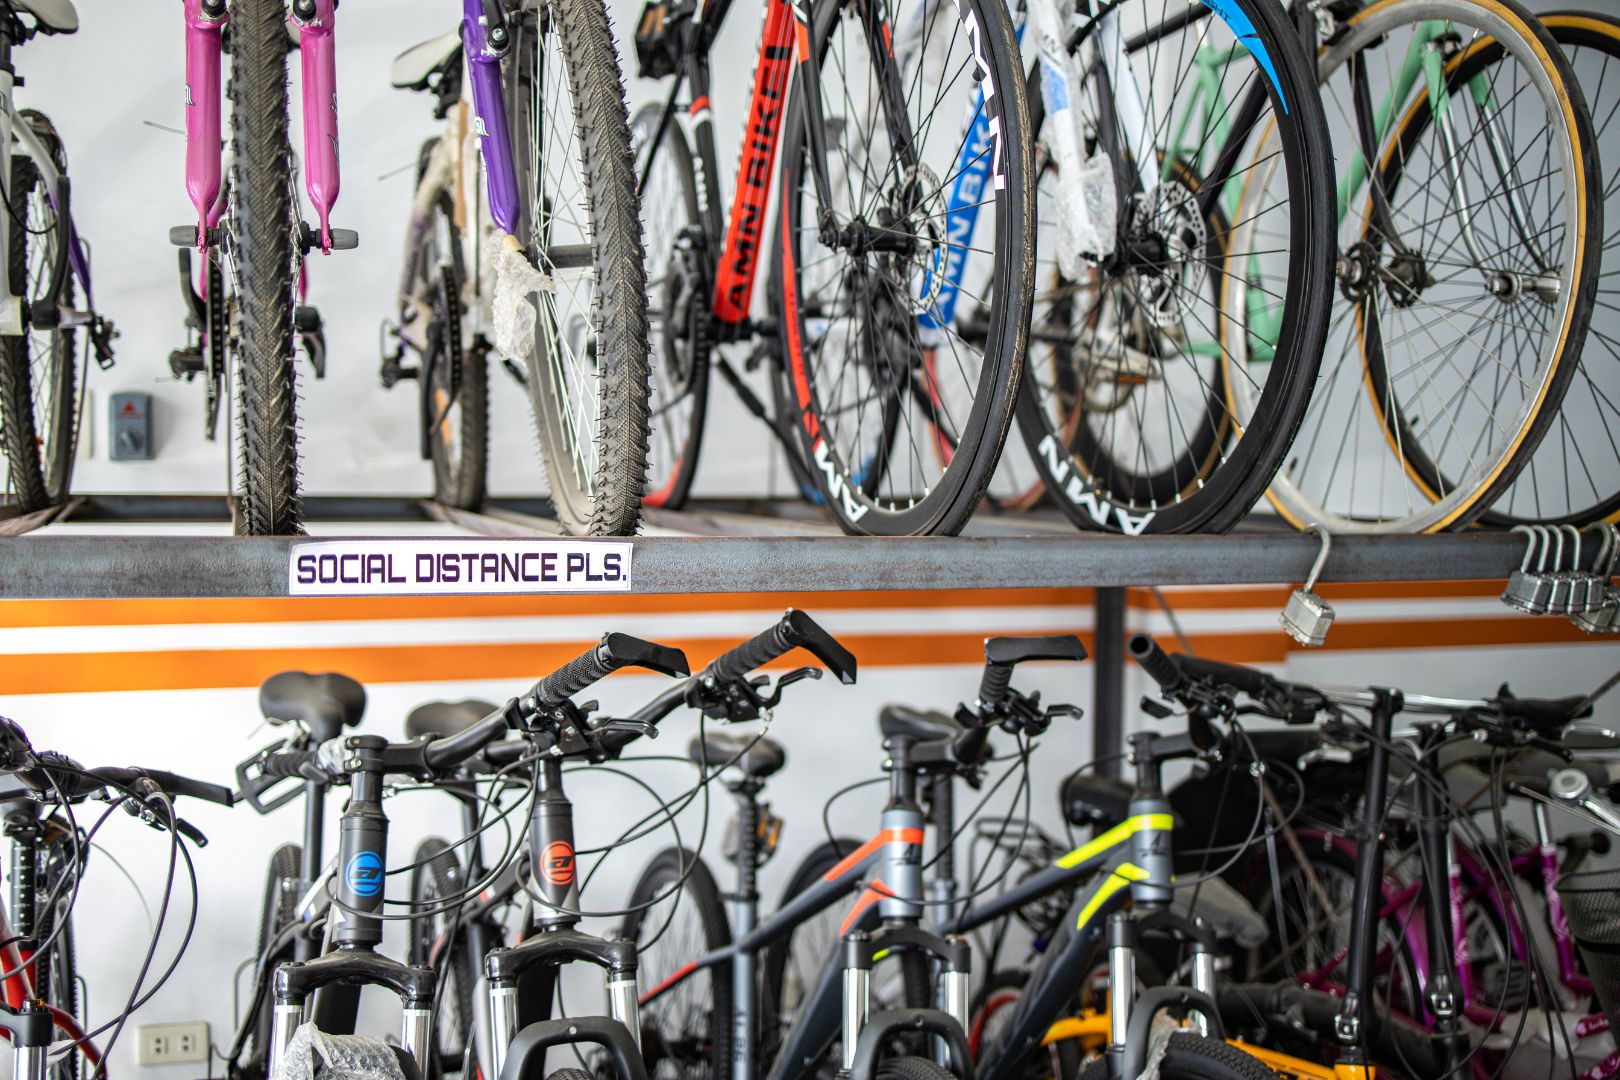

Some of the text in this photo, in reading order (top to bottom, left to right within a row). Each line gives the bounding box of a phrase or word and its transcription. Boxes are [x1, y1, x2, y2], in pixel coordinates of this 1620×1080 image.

[1038, 434, 1156, 537] AMN
[297, 552, 627, 584] SOCIAL DISTANCE PLS.
